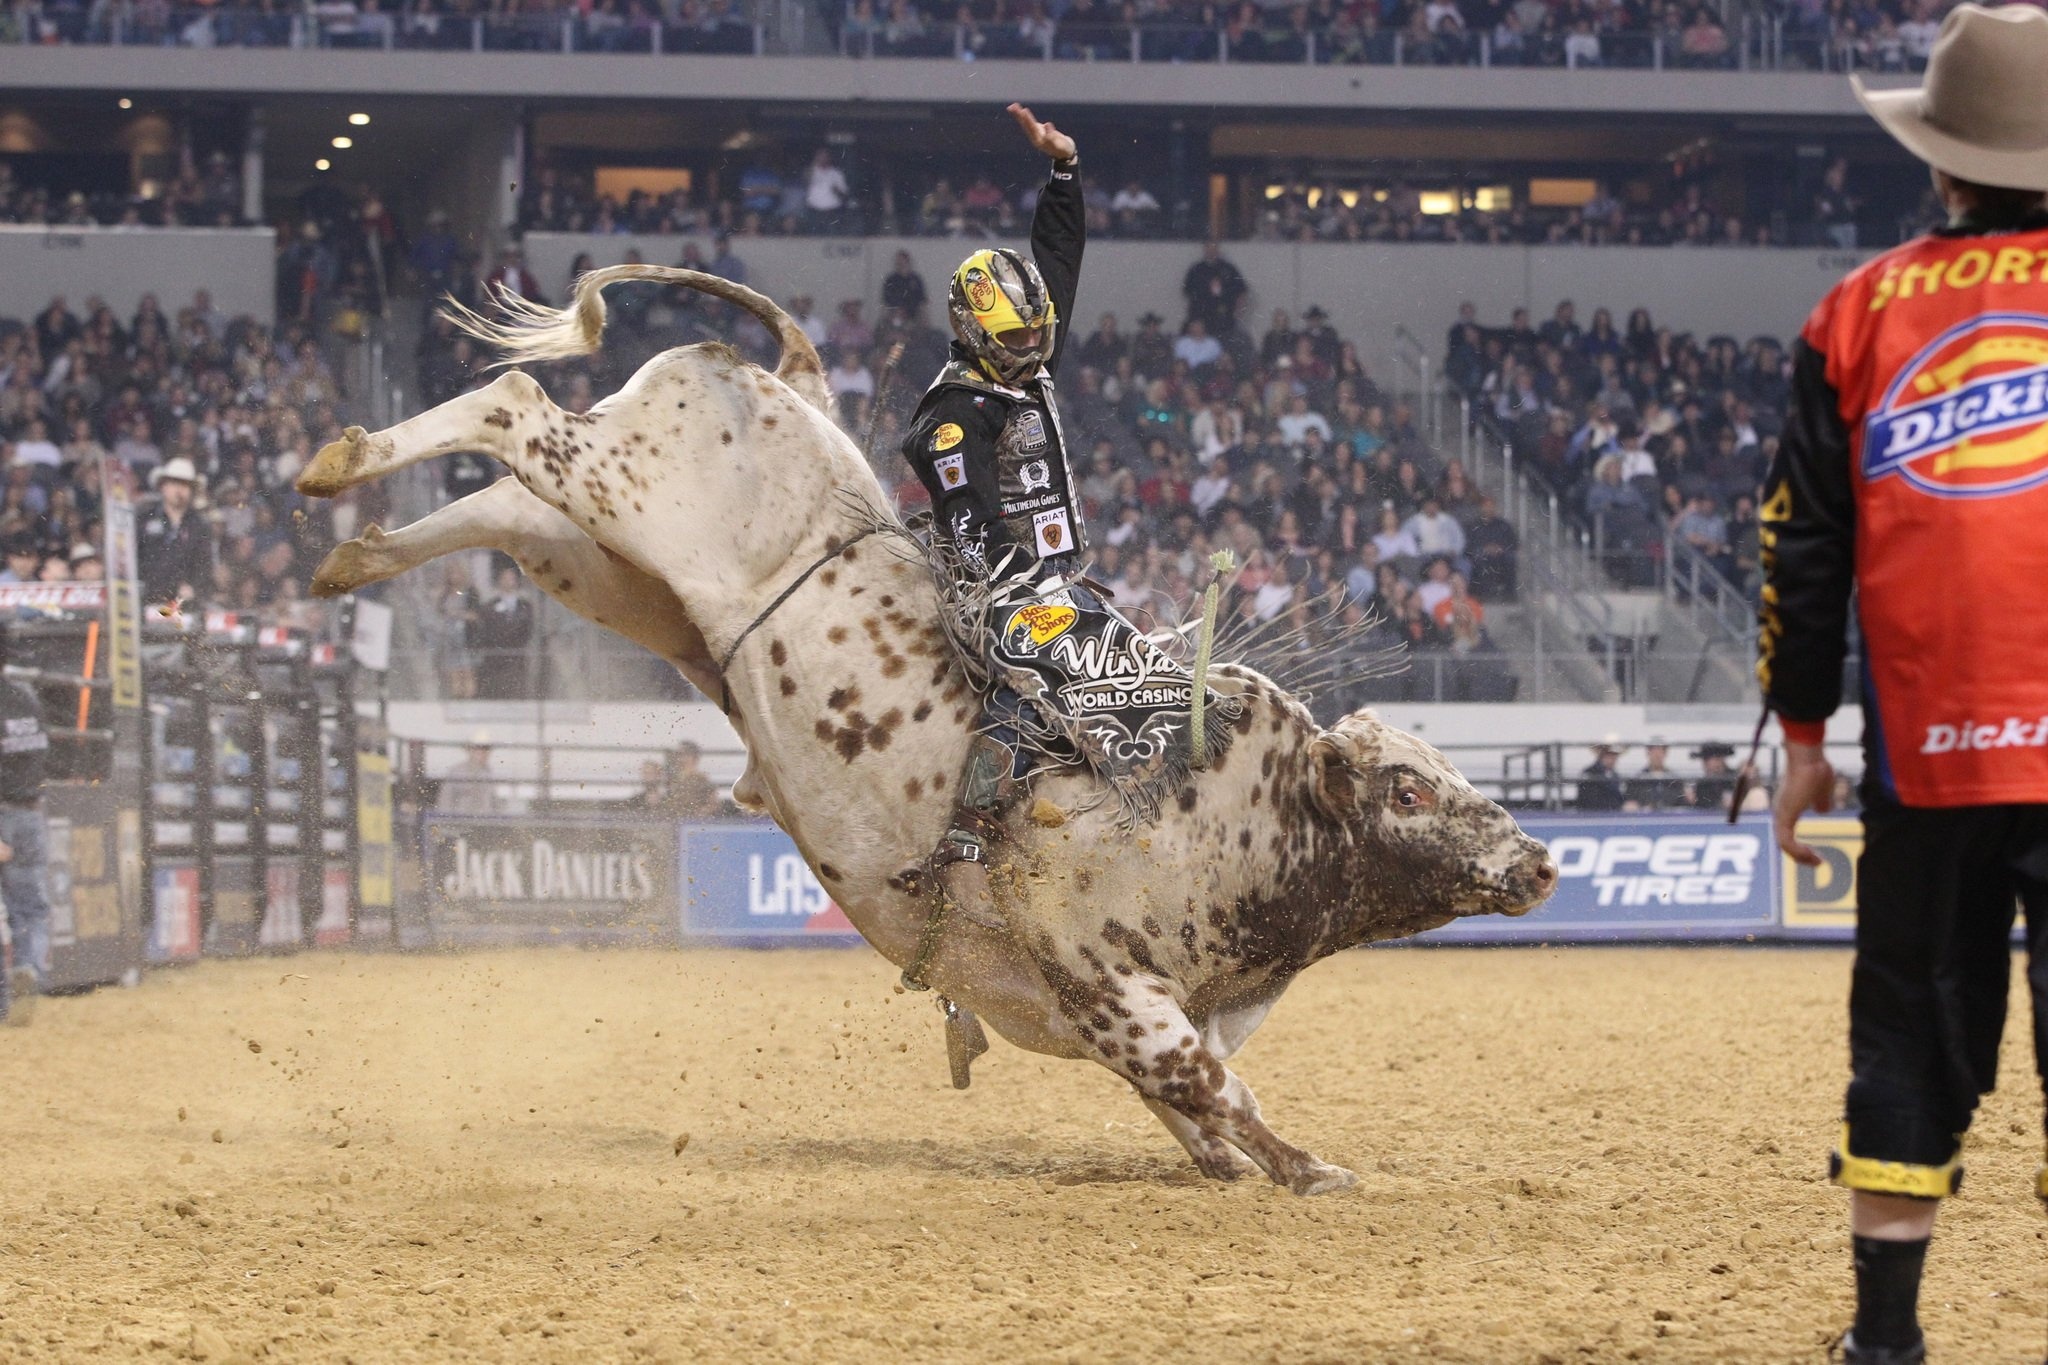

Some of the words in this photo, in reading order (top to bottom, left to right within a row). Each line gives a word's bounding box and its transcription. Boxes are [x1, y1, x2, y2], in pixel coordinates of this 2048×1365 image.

[1883, 373, 2048, 457] Dicki
[937, 456, 961, 468] ARIAT
[1004, 498, 1041, 514] MULTIMEDIA
[1041, 493, 1060, 505] GAMES
[1035, 510, 1066, 525] ARIAT
[1020, 605, 1051, 622] Bass
[1031, 612, 1052, 628] Pro
[1038, 613, 1074, 636] Shops
[1052, 617, 1180, 691] WinSta
[1066, 690, 1128, 716] WORLD
[1130, 686, 1193, 707] CASINO
[445, 838, 525, 899] JACK
[1540, 834, 1760, 877] OPER
[748, 853, 831, 914] LAS
[1591, 874, 1751, 906] TIRES
